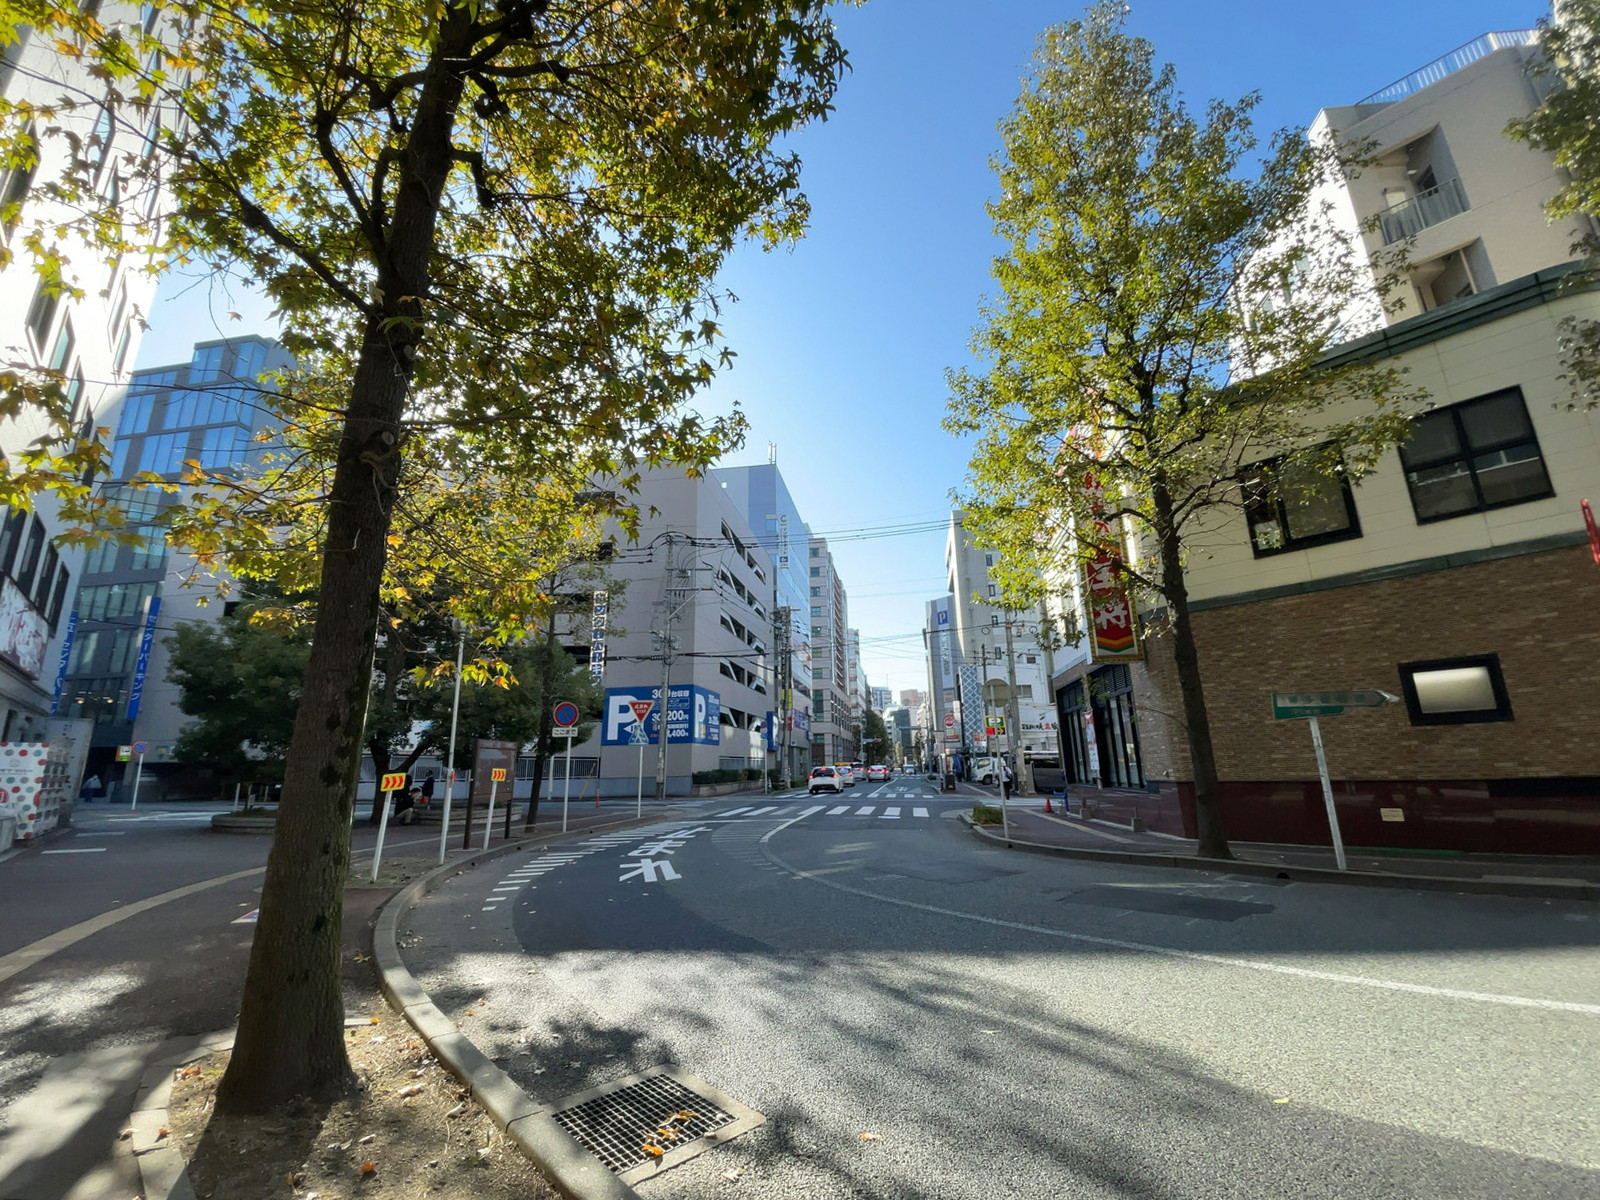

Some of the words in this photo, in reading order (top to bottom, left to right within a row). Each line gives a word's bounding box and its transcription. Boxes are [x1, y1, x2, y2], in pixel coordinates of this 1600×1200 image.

[939, 613, 946, 624] P
[131, 615, 157, 700] センターパーキング
[607, 695, 642, 740] P
[695, 693, 706, 738] P
[619, 827, 713, 882] 止まれ
